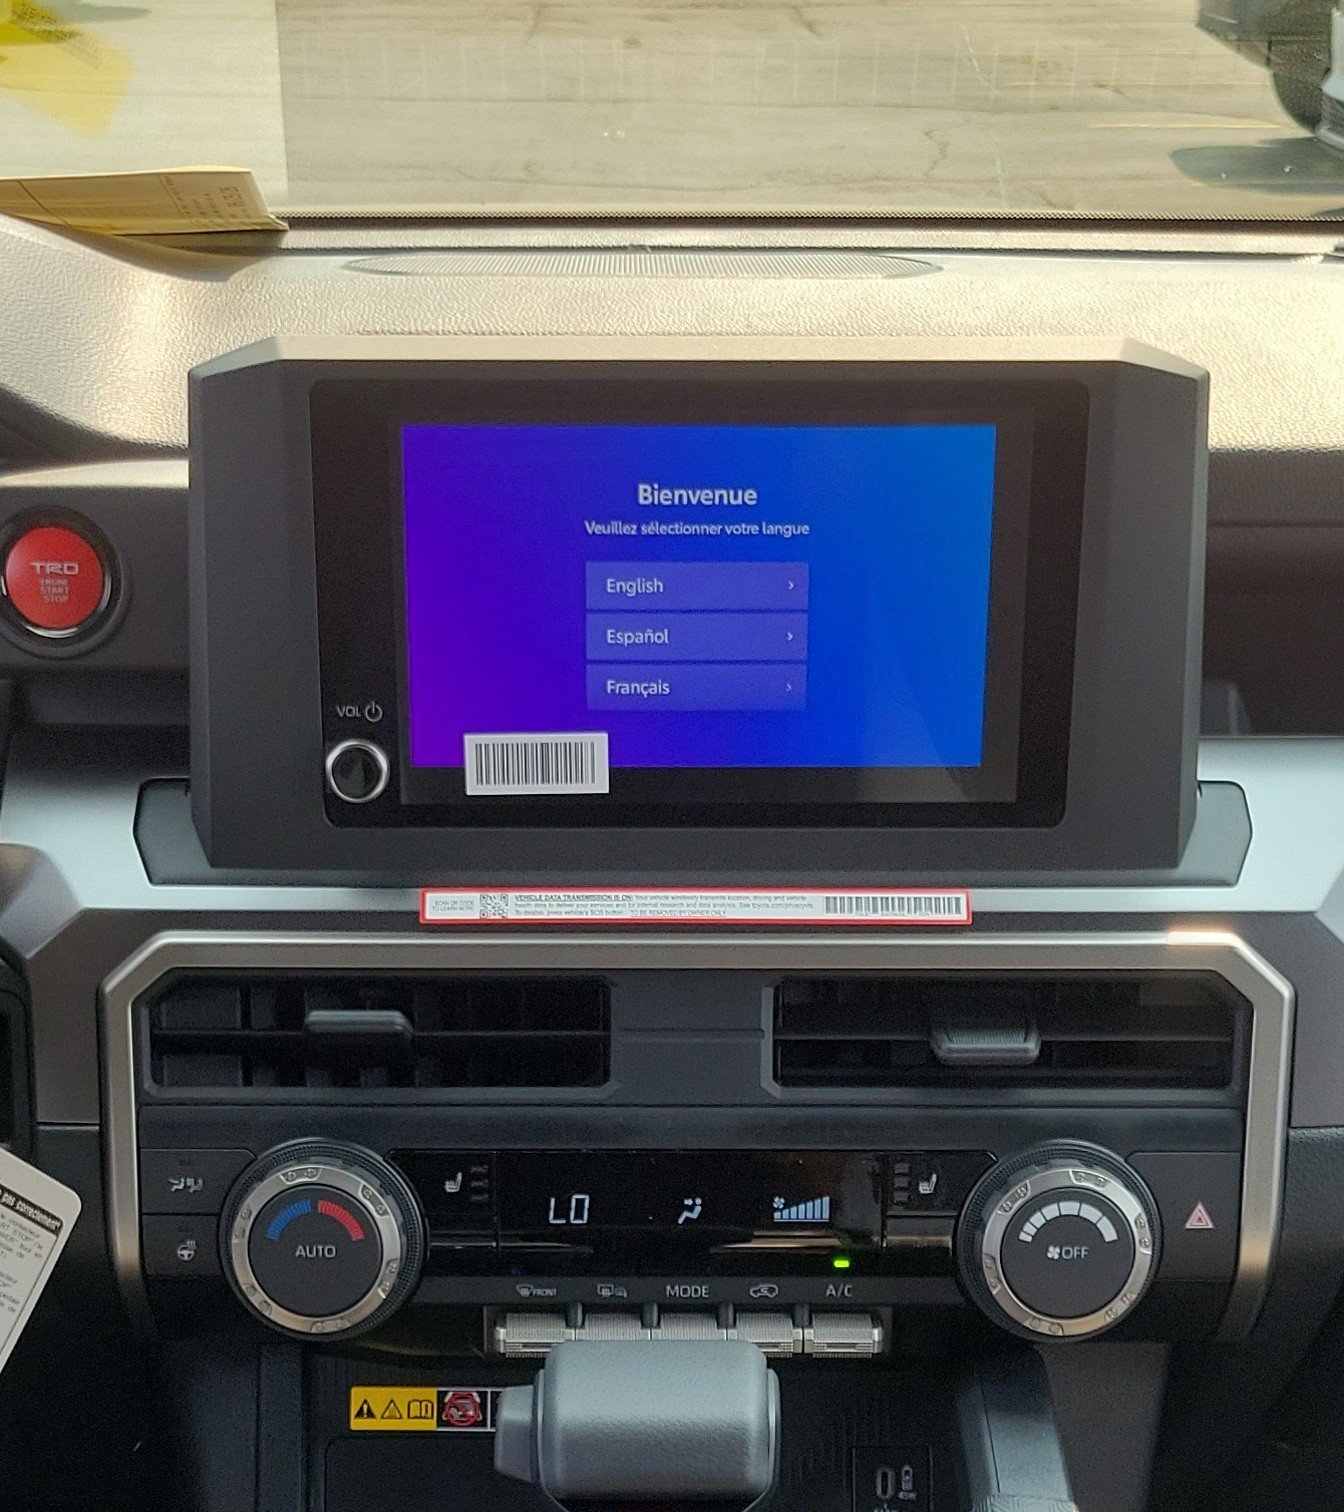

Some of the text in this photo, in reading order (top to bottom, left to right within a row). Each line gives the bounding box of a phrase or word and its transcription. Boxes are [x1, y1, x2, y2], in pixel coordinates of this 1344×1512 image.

[637, 483, 758, 506] Bienvenue
[584, 520, 810, 538] Veuillez sélectionner votre langue
[29, 562, 79, 575] TRD
[606, 577, 664, 597] English
[606, 628, 670, 647] Español
[606, 679, 671, 698] Français
[337, 705, 362, 717] VOL
[548, 1194, 590, 1224] LO
[295, 1245, 337, 1258] AUTO
[1061, 1246, 1090, 1258] OFF
[666, 1284, 710, 1299] MODE
[826, 1284, 853, 1299] A/C
